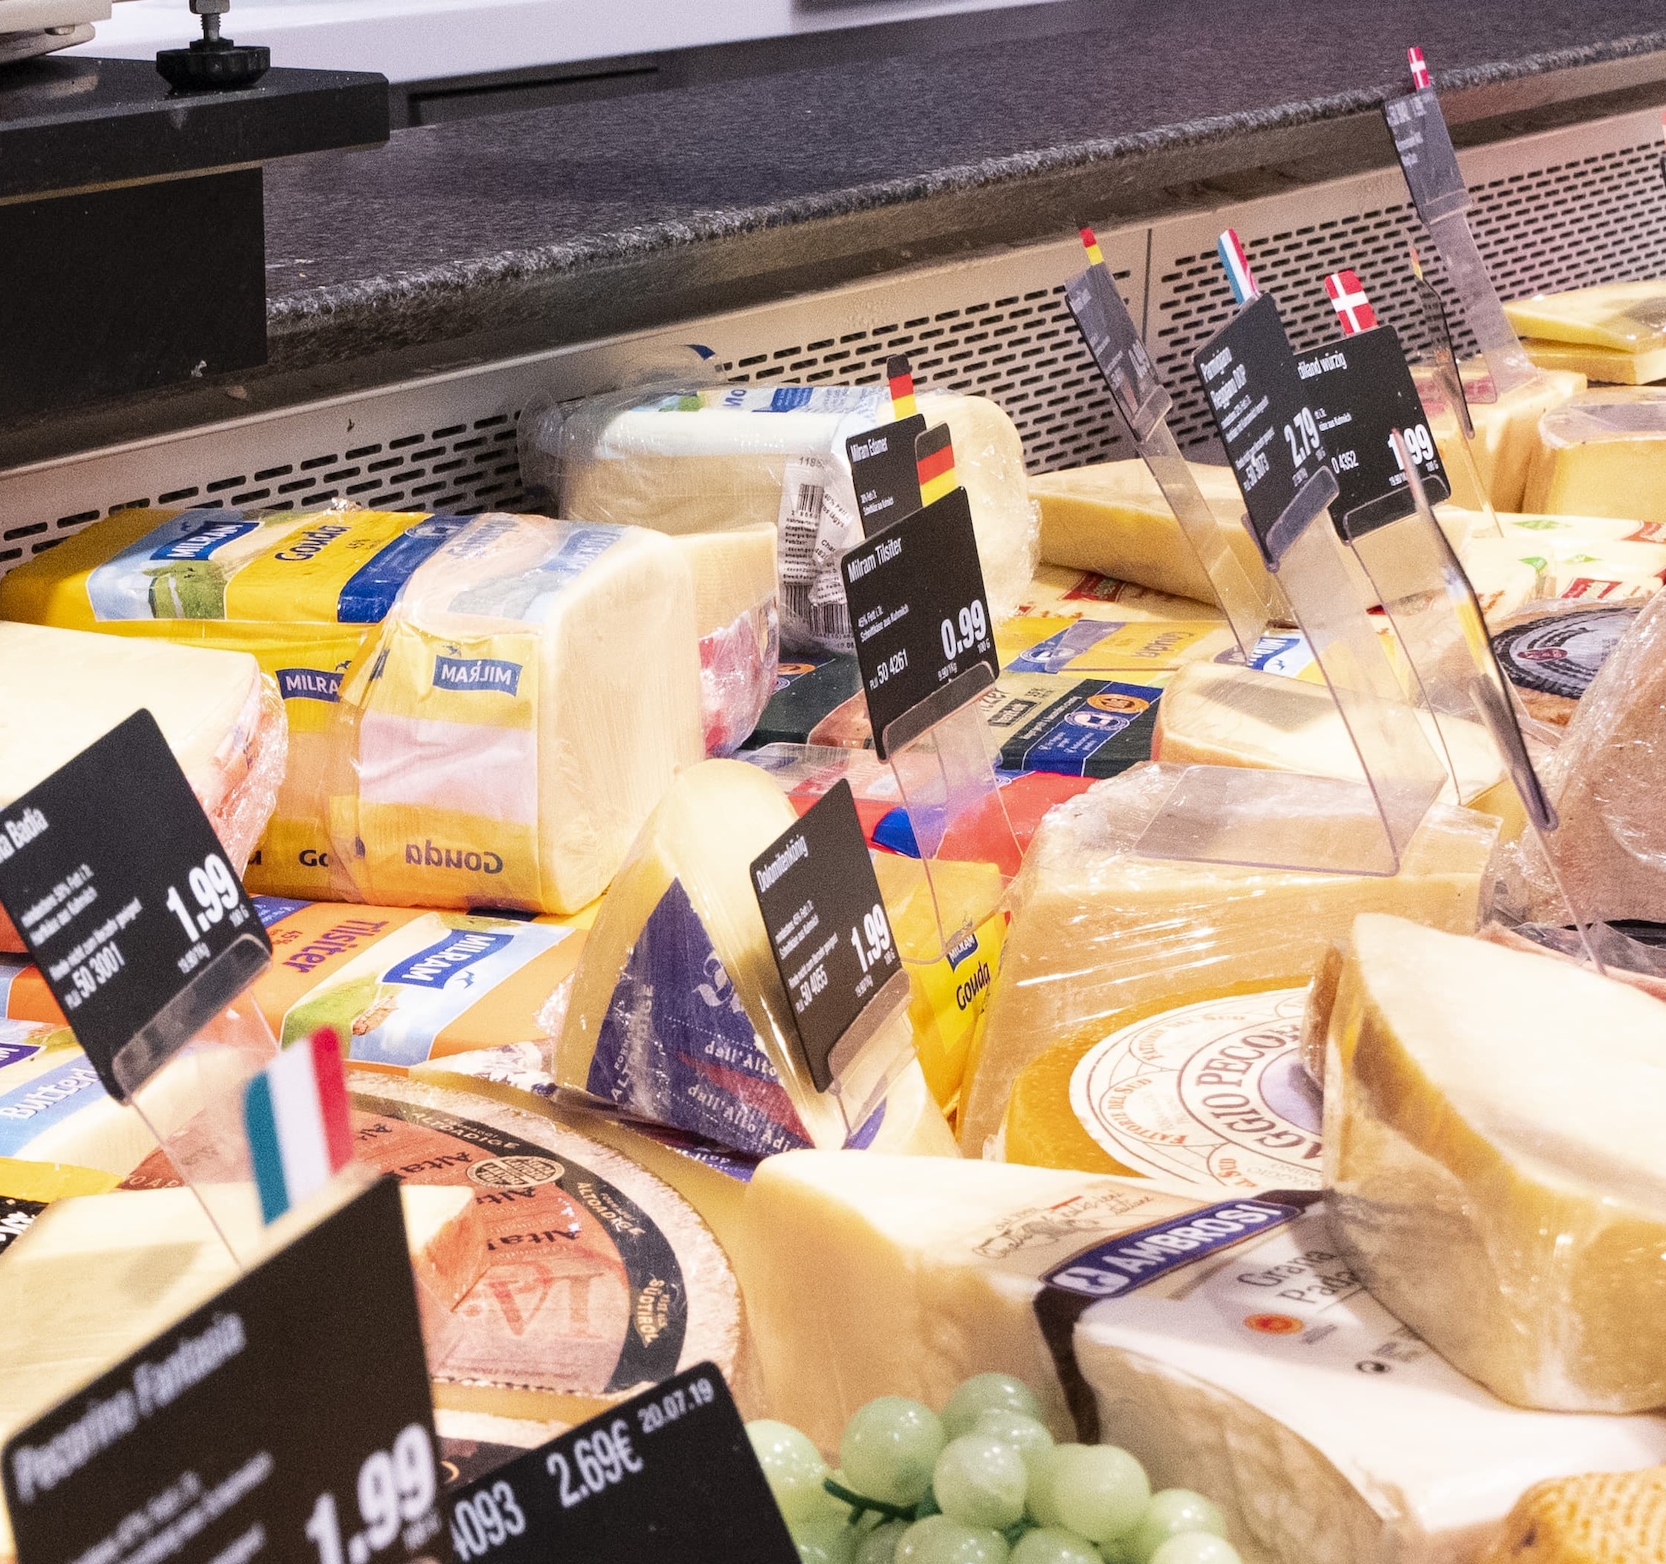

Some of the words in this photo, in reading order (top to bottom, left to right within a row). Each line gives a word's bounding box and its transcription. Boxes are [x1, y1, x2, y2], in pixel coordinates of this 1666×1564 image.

[1284, 407, 1319, 468] 2.79
[1339, 450, 1359, 471] 4352
[1388, 424, 1434, 470] 199
[168, 521, 240, 559] MILRAM
[275, 523, 350, 562] Gouda
[847, 554, 877, 583] Milram
[875, 537, 902, 564] Tilsiter
[940, 599, 988, 661] 0.99
[285, 674, 339, 693] MILRA
[877, 661, 889, 684] 50
[889, 648, 909, 676] 4261
[4, 806, 49, 850] Badia
[166, 853, 240, 943] 1.99
[281, 919, 390, 974] Tilsiter
[401, 934, 495, 983] MILRAM
[851, 903, 891, 974] 1.99
[72, 964, 98, 998] 50
[88, 940, 126, 985] 3001
[955, 960, 992, 1012] Gouda
[577, 1181, 647, 1236] ALTOADIGE
[1101, 1203, 1284, 1274] AMBROSI
[1236, 1248, 1339, 1288] Grana
[11, 1390, 137, 1503] Pecorino
[131, 1311, 247, 1418] Fantasia
[546, 1418, 644, 1508] 2.69€
[637, 1378, 716, 1435] 20.07.19
